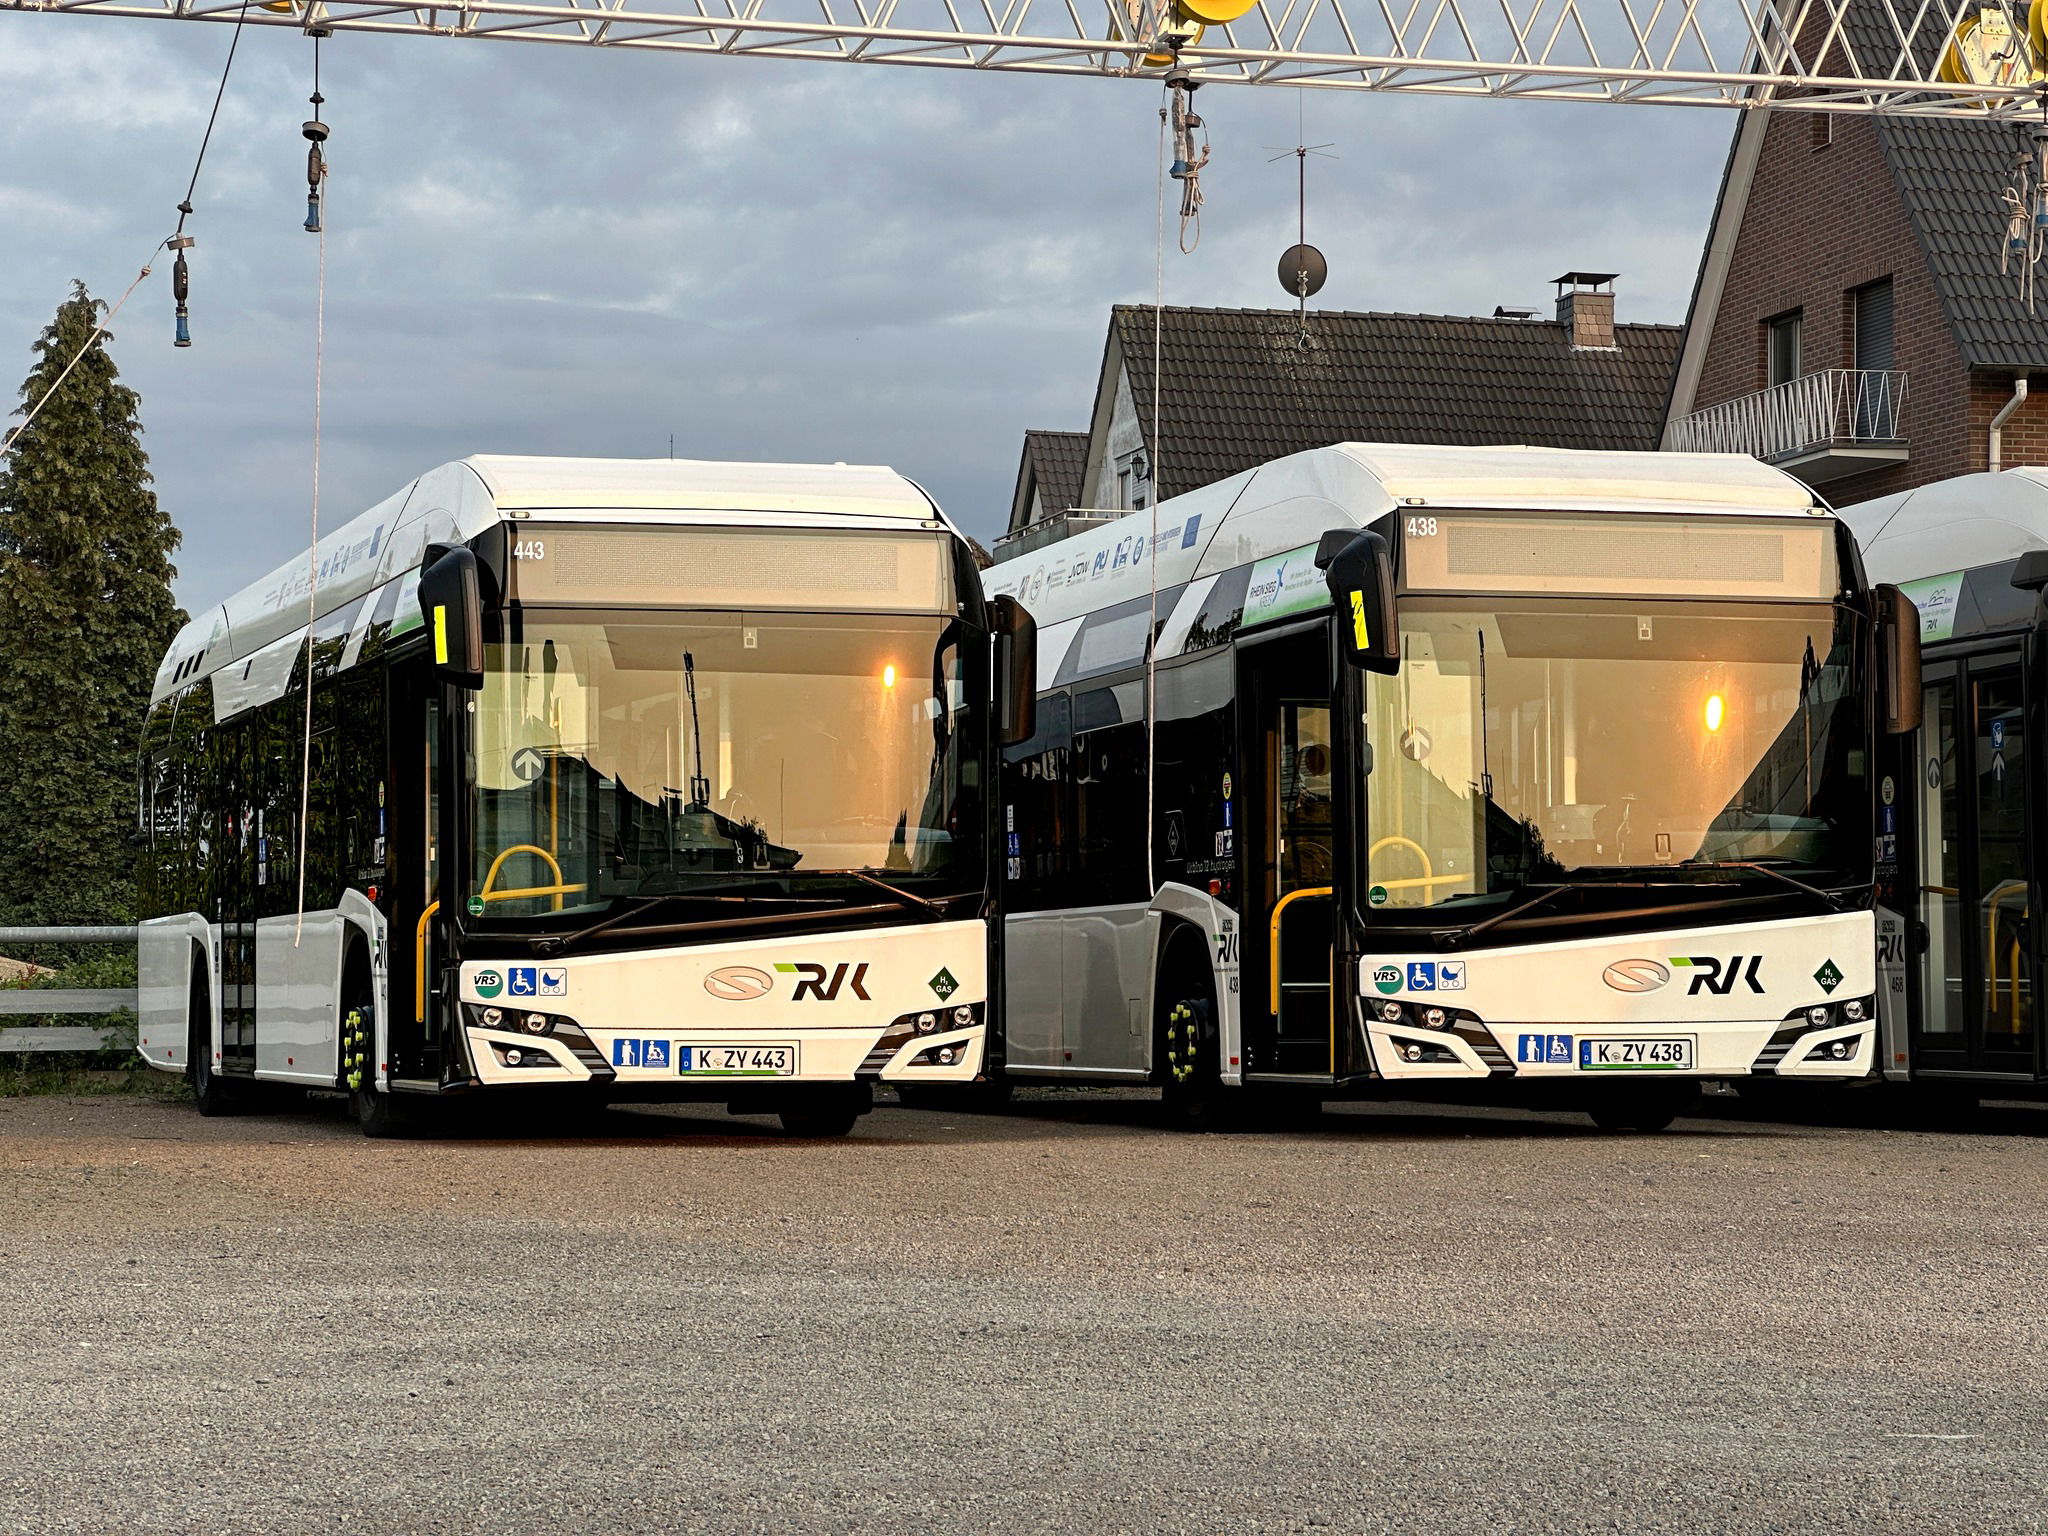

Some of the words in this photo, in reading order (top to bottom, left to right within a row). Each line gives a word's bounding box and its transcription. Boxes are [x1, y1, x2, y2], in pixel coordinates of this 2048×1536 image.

[1407, 517, 1437, 536] 438
[514, 541, 544, 560] 443
[1210, 860, 1236, 873] hydrogen
[1213, 934, 1238, 962] RVK
[473, 975, 496, 985] VRS
[773, 963, 872, 1001] RVK
[1373, 971, 1397, 981] VRS
[1668, 955, 1766, 996] RVK
[1820, 977, 1837, 986] GAS
[1891, 976, 1904, 993] 468
[935, 985, 953, 994] GAS
[699, 1050, 711, 1068] K
[724, 1050, 747, 1068] ZY
[751, 1050, 785, 1068] 443
[1598, 1044, 1610, 1062] K
[1623, 1044, 1645, 1062] ZY
[1650, 1044, 1683, 1062] 438
